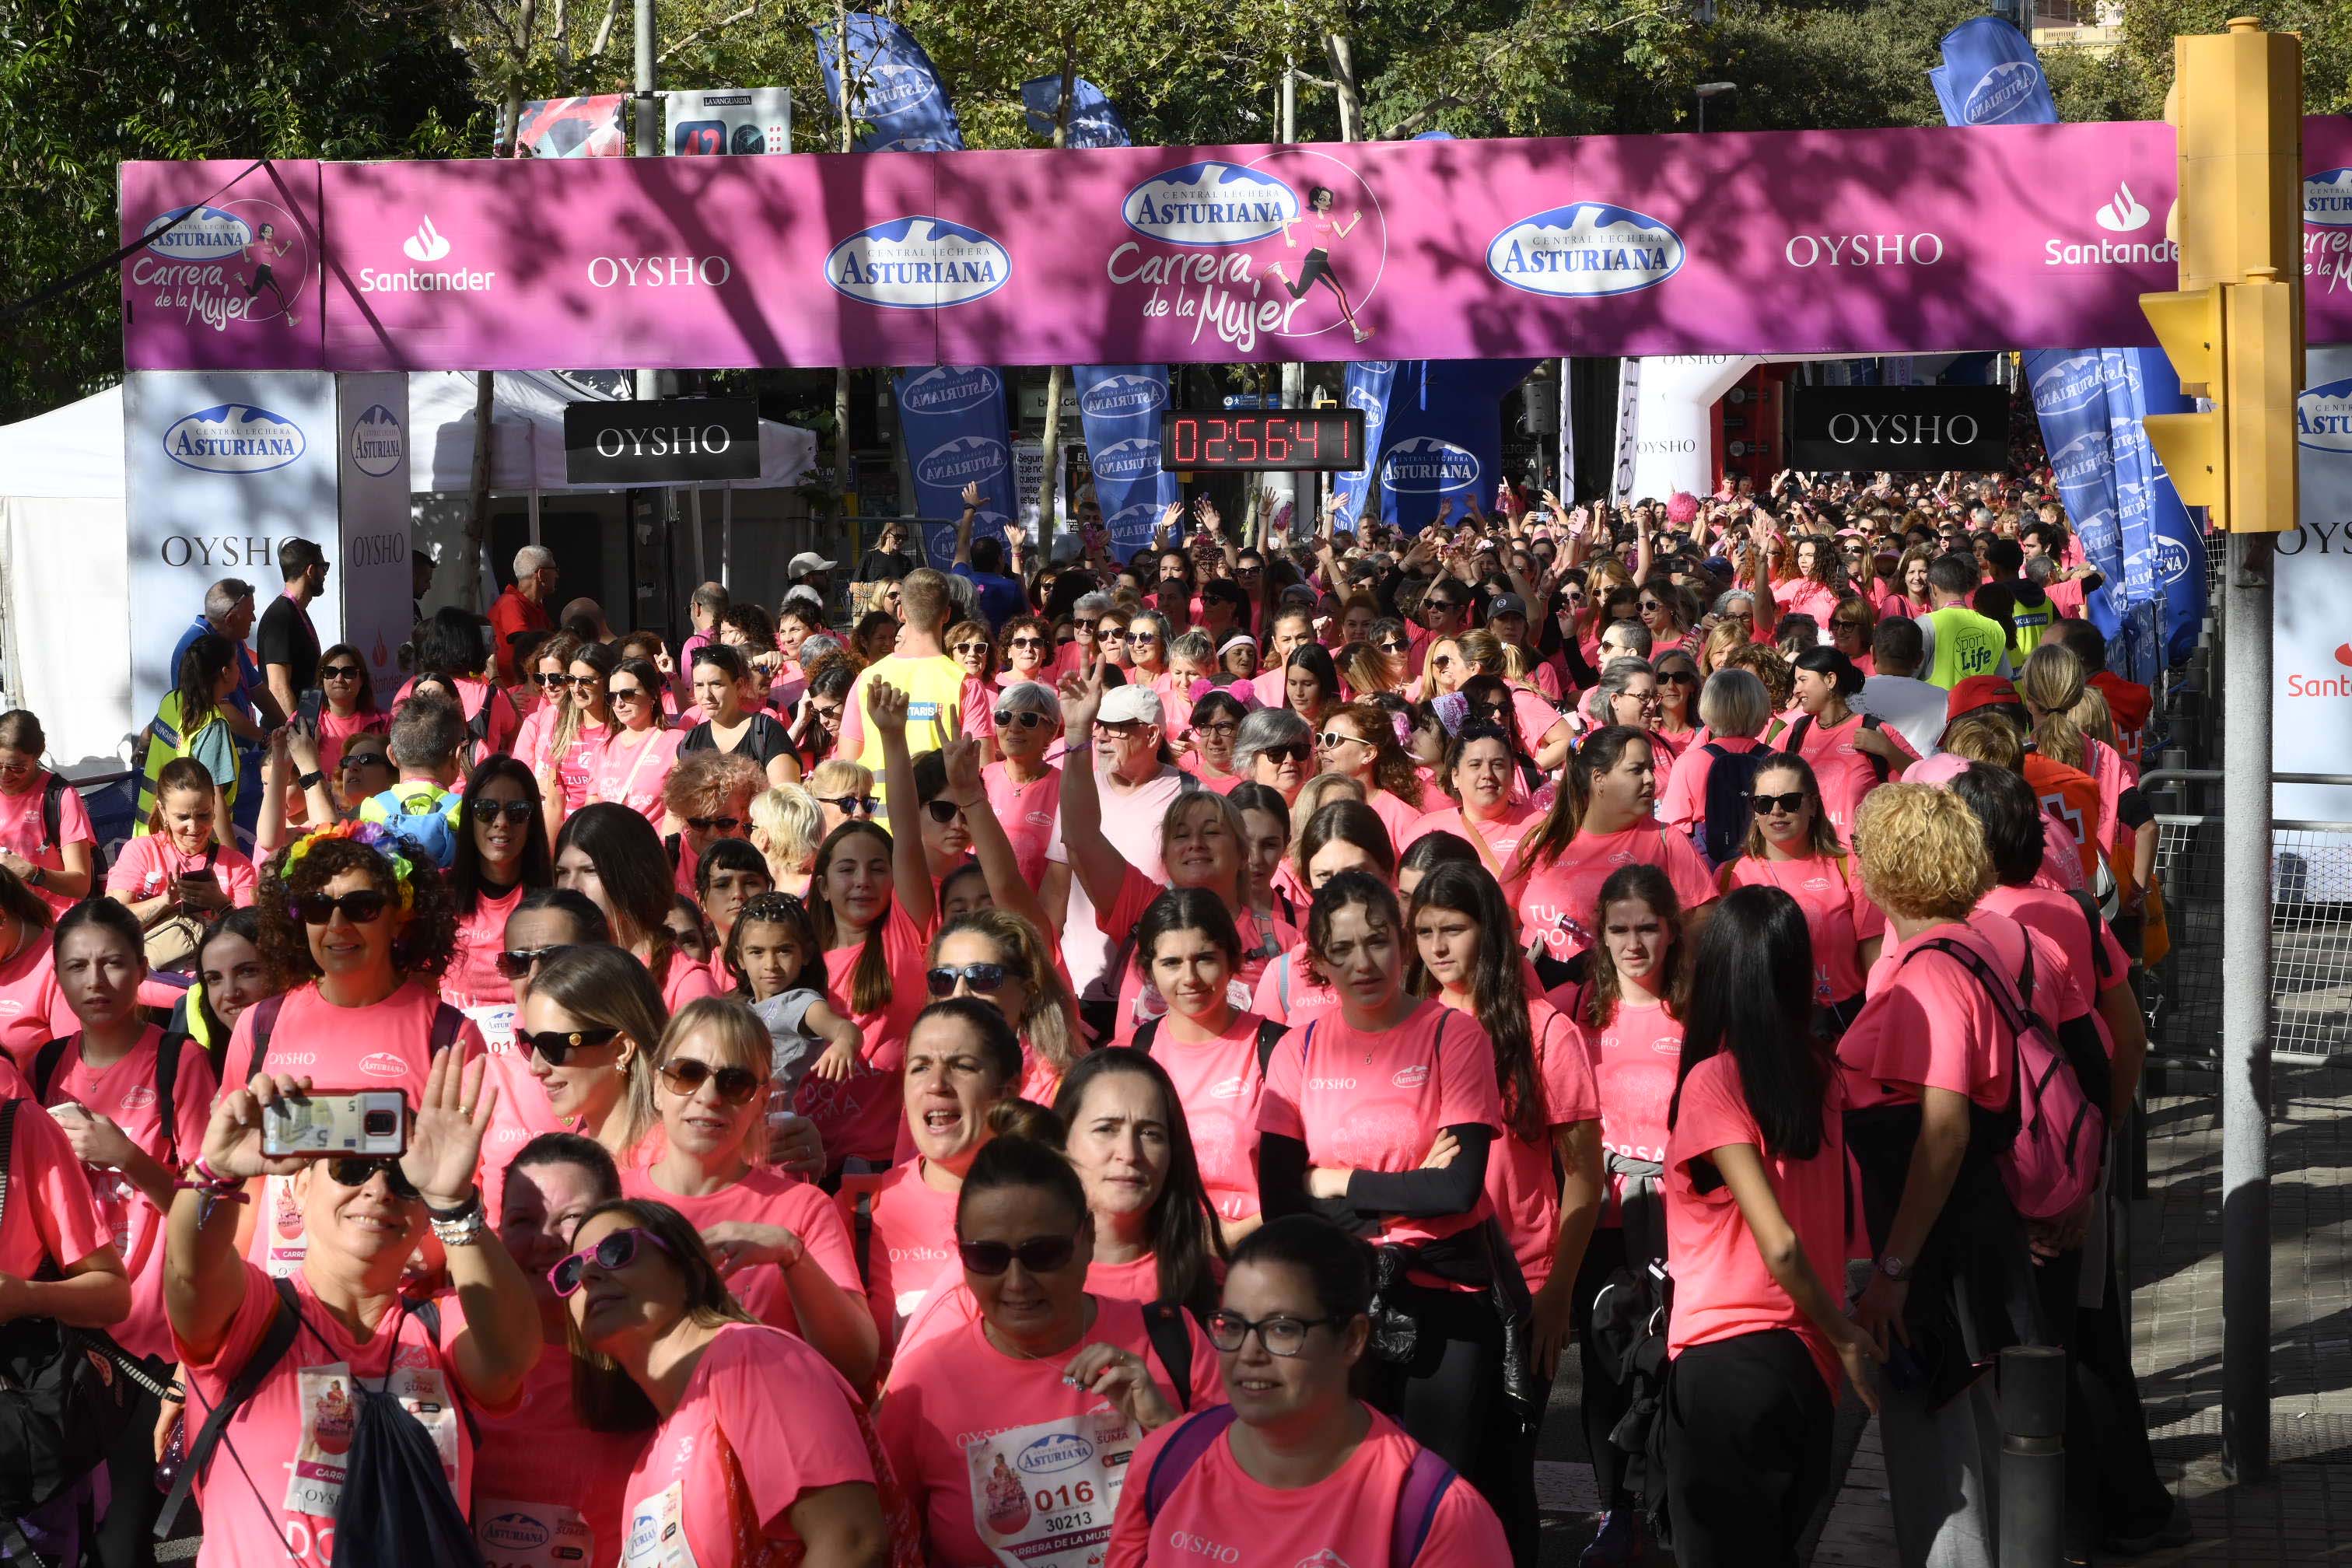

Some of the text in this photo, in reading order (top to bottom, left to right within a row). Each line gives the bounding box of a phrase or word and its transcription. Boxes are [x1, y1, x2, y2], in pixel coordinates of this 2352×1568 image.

[713, 96, 751, 105] VANGUARDIA
[1162, 188, 1279, 199] CENTRAL LECHERA
[1136, 193, 1285, 225] ASTURIANA
[151, 226, 244, 247] ASTURIANA
[169, 223, 201, 232] ENTRAL
[1532, 233, 1663, 246] CENTRAL LECHERA
[1786, 233, 1944, 268] OYSHO
[867, 247, 991, 257] CENTRAL LECHERA
[1107, 241, 1252, 285] Carrera
[1502, 238, 1669, 274] ASTURIANA
[132, 257, 224, 285] Carrera
[588, 257, 730, 287] OYSHO
[839, 250, 996, 285] ASTURIANA
[2317, 254, 2332, 275] la
[360, 268, 495, 293] Santander
[156, 284, 258, 331] de la Mujer
[1143, 278, 1307, 352] de la Mujer
[1828, 413, 1979, 445] OYSHO
[175, 429, 295, 457] ASTURIANA
[355, 432, 400, 460] ASTURIANA
[596, 425, 730, 457] OYSHO
[1636, 438, 1696, 455] OYSHO
[1384, 460, 1472, 481] ASTURIANA
[352, 532, 404, 568] OYSHO
[1955, 632, 1986, 653] Sport
[1961, 646, 1992, 673] Life
[907, 706, 935, 716] TARIS
[1529, 905, 1555, 922] TU
[268, 1052, 407, 1074] OYSHO ASTURIANA
[1309, 1077, 1357, 1090] OYSHO
[889, 1247, 948, 1263] OYSHO
[1096, 1432, 1129, 1445] SUMA
[1024, 1446, 1089, 1469] ASTURIANA
[1034, 1480, 1094, 1512] 016
[1045, 1511, 1092, 1532] 30213
[487, 1524, 543, 1544] ASTURIANA
[1013, 1541, 1052, 1557] ARRERA
[1054, 1538, 1068, 1548] DE
[1069, 1535, 1083, 1545] LA
[1170, 1530, 1240, 1564] OYSHO
